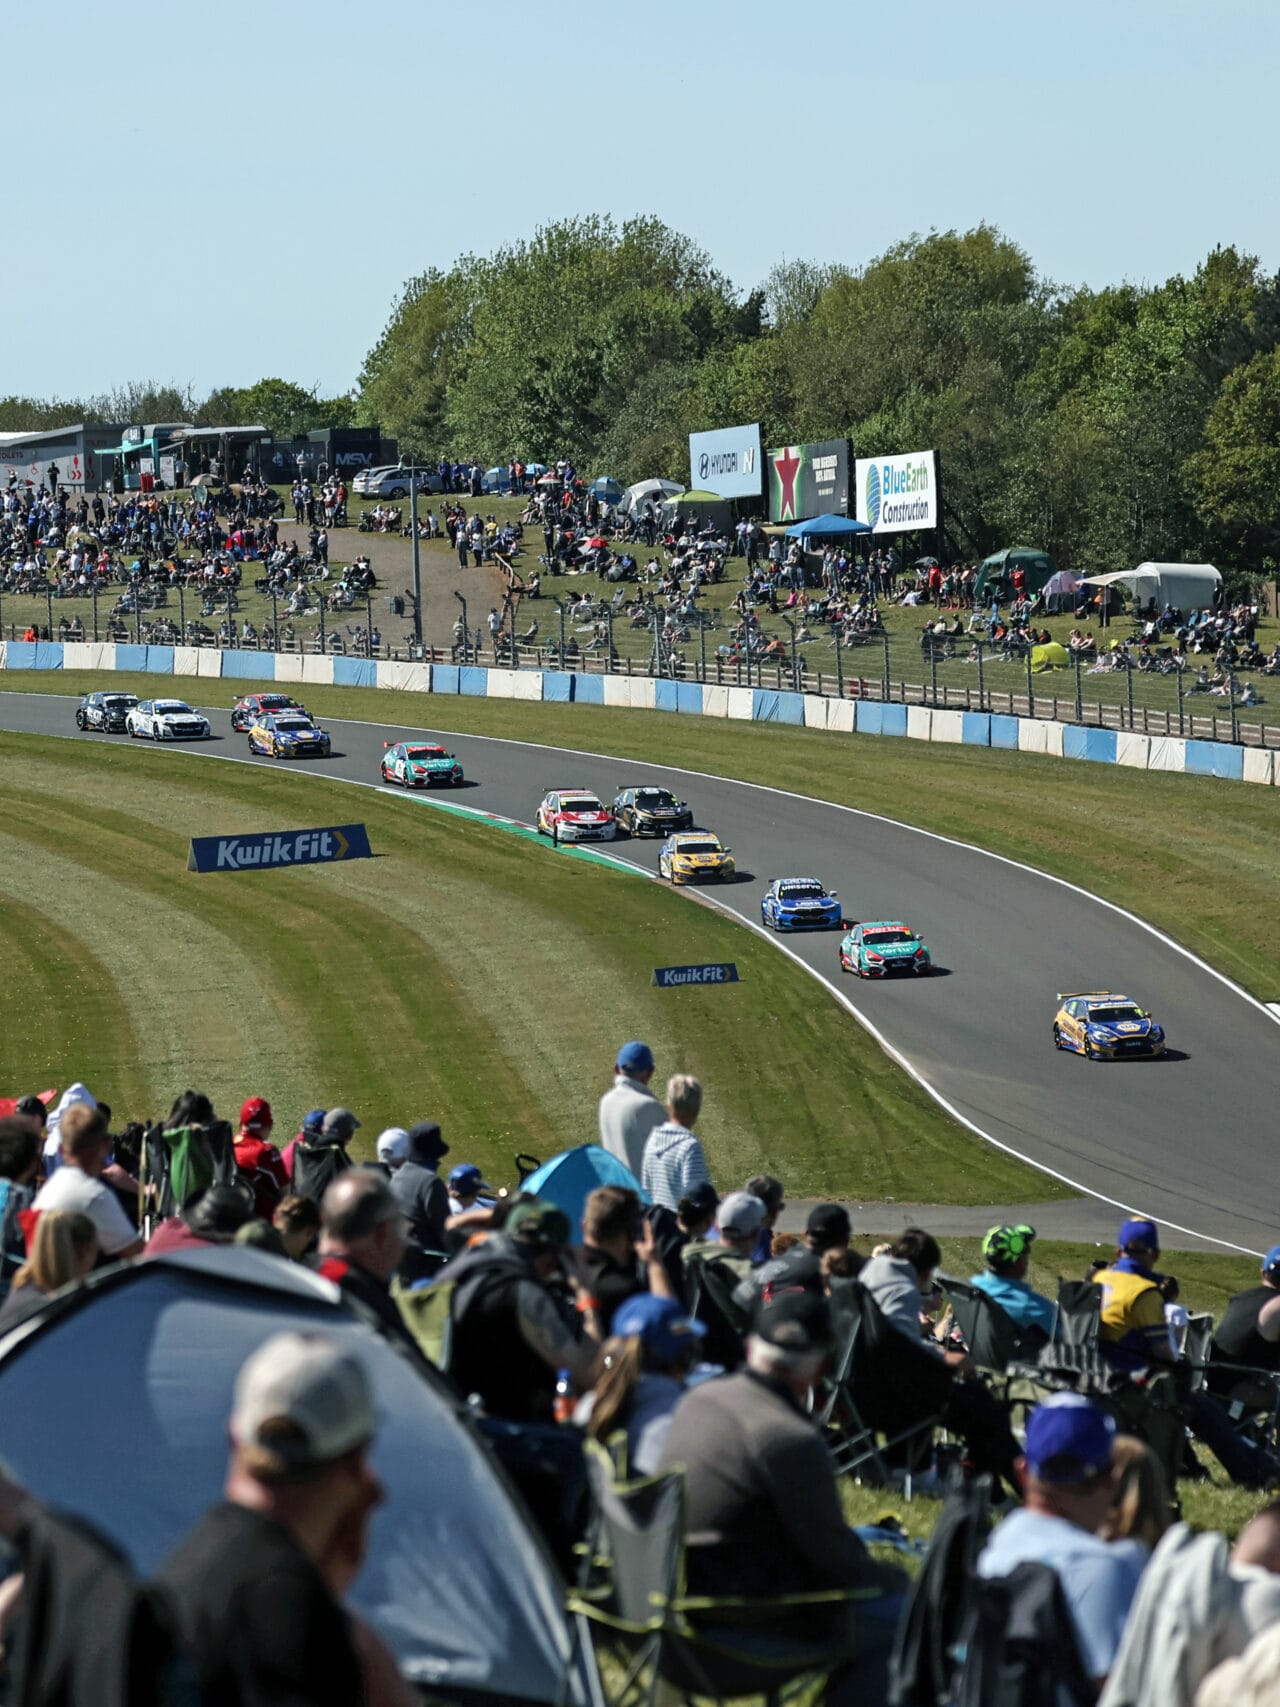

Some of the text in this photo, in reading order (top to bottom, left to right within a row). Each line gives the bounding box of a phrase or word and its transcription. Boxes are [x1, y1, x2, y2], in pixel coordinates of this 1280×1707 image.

[336, 453, 373, 465] MSV
[711, 447, 754, 475] HYUNDAI N
[883, 460, 928, 495] BlueEarth
[883, 497, 929, 524] Construction
